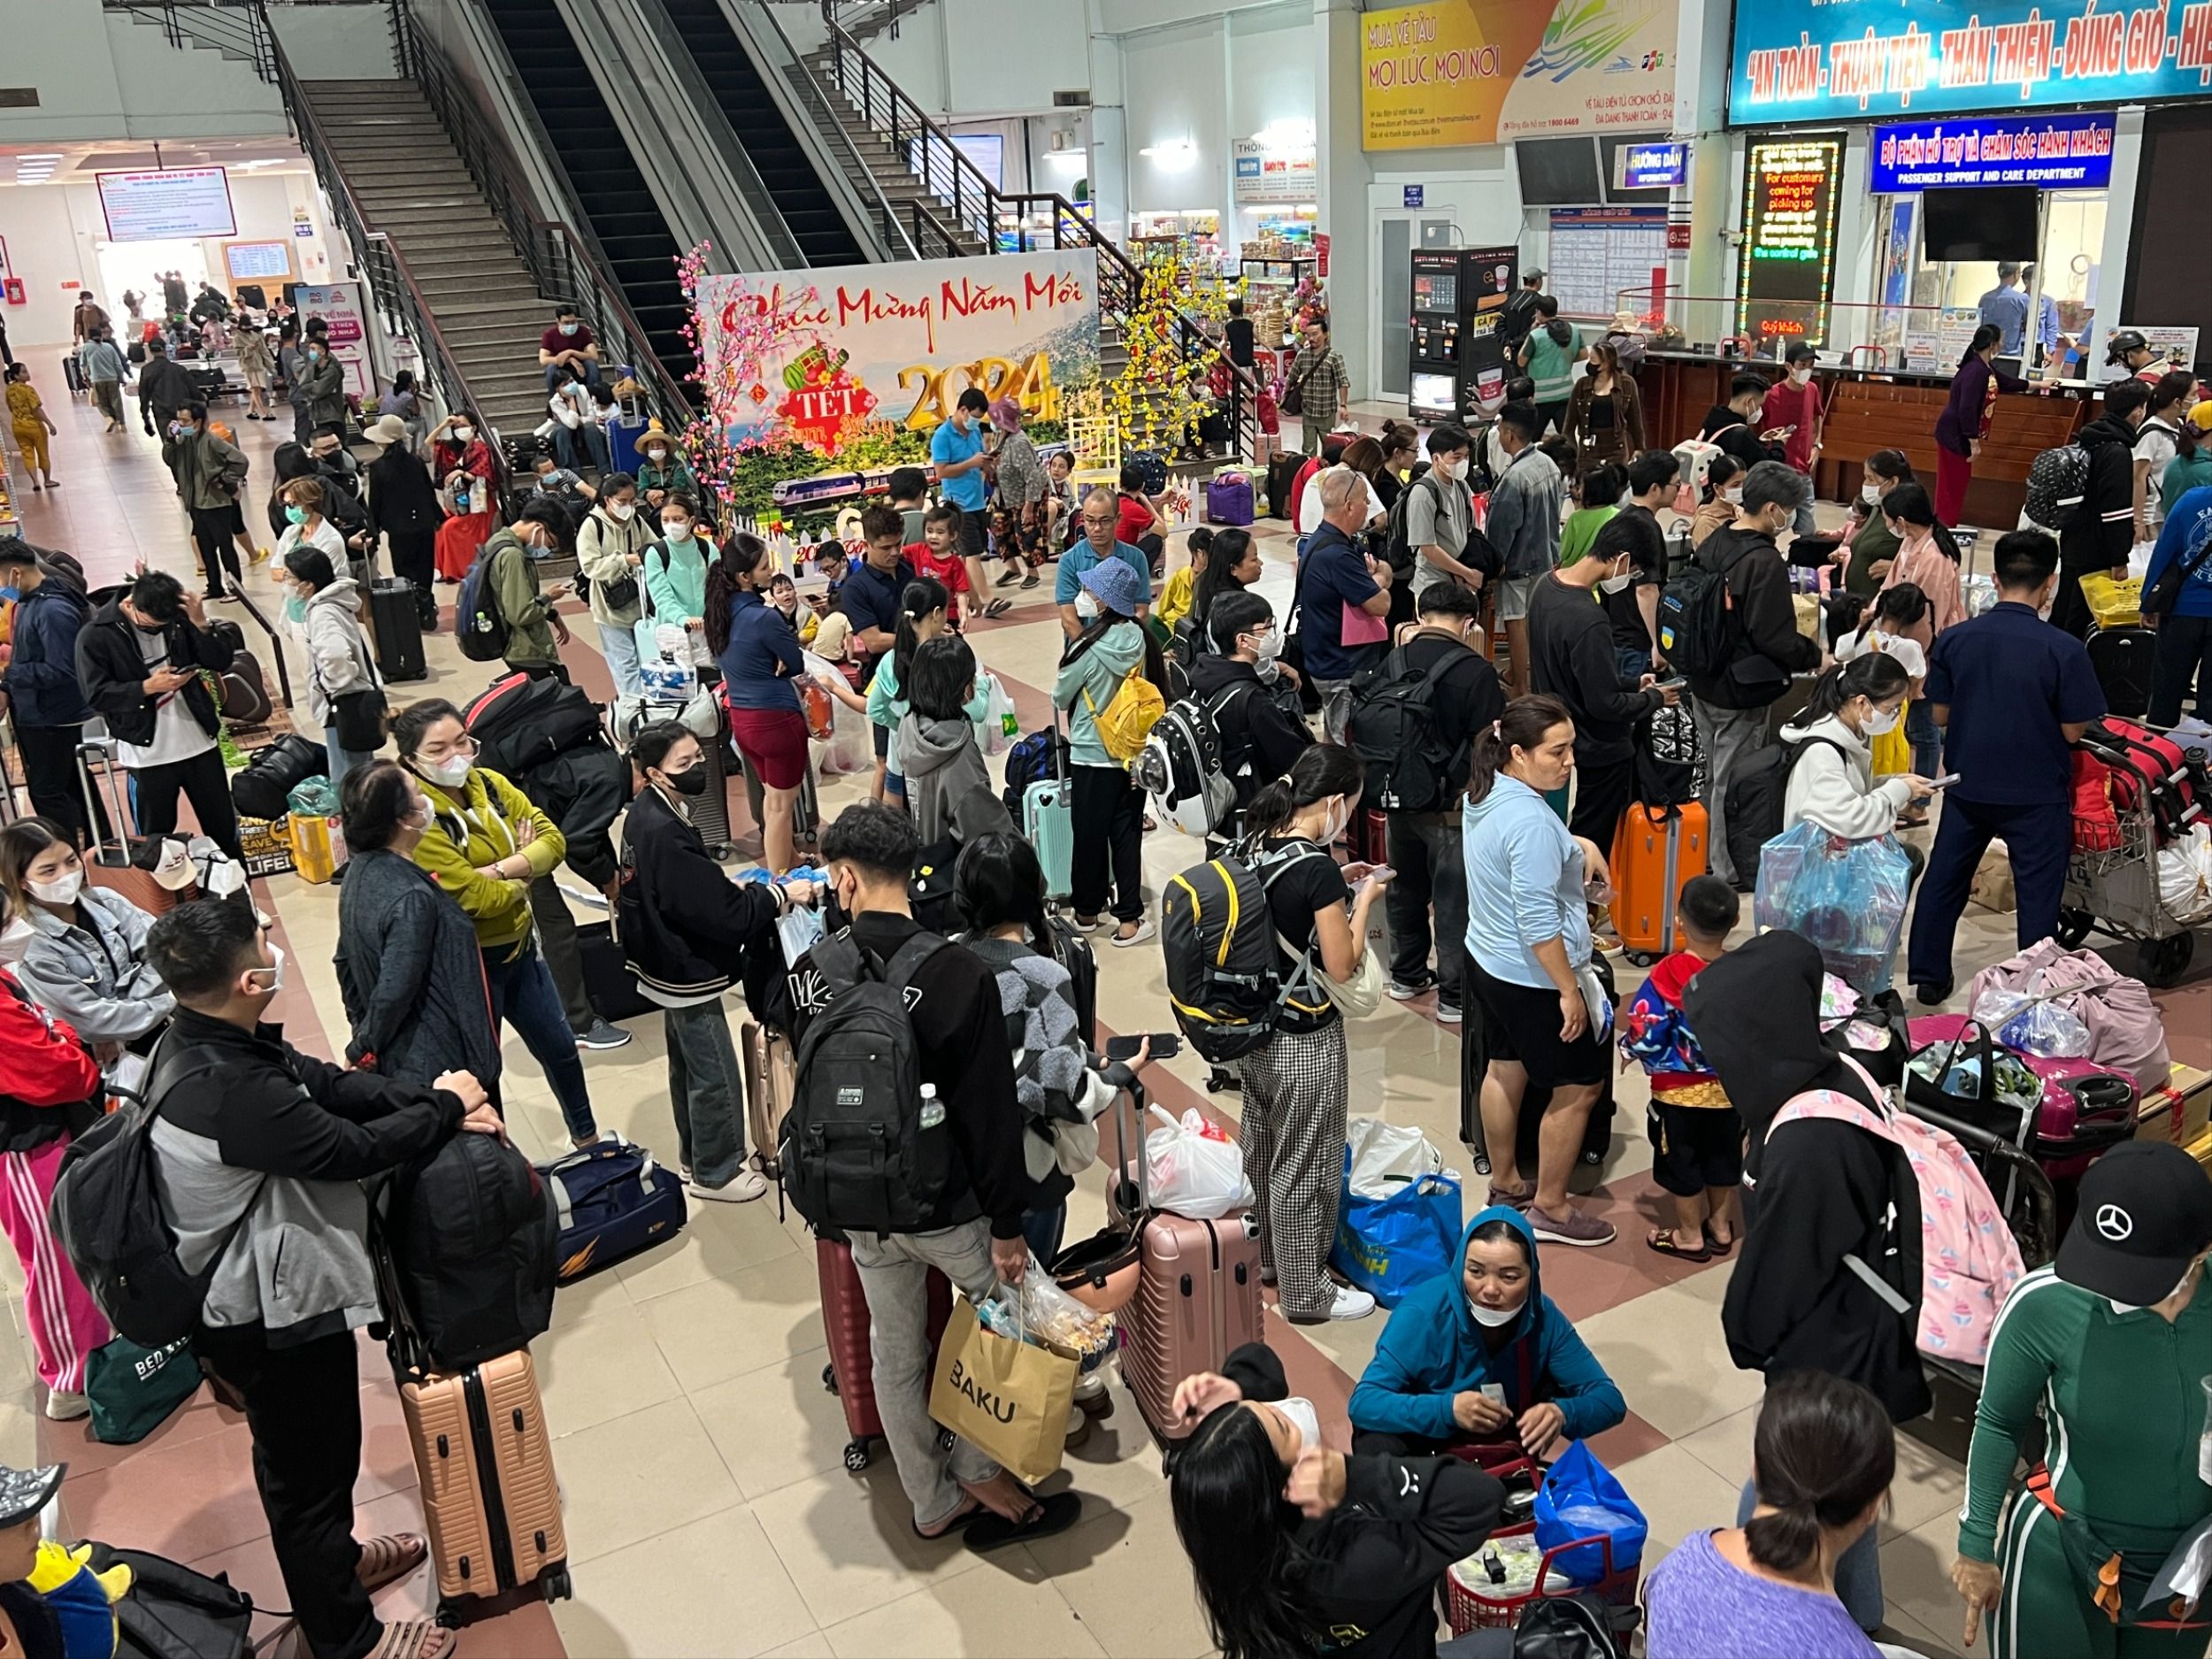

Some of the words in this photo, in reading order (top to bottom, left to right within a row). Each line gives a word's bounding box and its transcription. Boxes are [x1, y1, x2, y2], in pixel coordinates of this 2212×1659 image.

[1368, 22, 1394, 50] MUA
[1412, 10, 1438, 44] TÀU
[1641, 50, 1664, 72] FPT
[1778, 31, 1821, 101] TOÀN
[1829, 26, 1887, 111] THUẬN
[1887, 21, 1931, 107] TIỆN
[1939, 14, 1993, 88] THÂN
[1993, 8, 2055, 99] THIỆN
[2062, 0, 2125, 80] ĐÚNG
[2124, 0, 2170, 75] GIỜ
[1369, 58, 1397, 93] MỌI
[1435, 50, 1467, 88] MỌI
[1470, 44, 1502, 78] NƠI
[1564, 117, 1579, 126] 6469
[1881, 134, 1896, 170] BỘ
[1897, 133, 1925, 169] PHẬN
[1942, 133, 1965, 167] TRỢ
[1965, 129, 1979, 162] VÀ
[1981, 129, 2013, 161] CHĂM
[2013, 127, 2037, 160] SÓC
[2037, 125, 2070, 158] HÀNH
[2070, 122, 2111, 157] KHÁCH
[1631, 150, 1662, 169] HƯỚNG
[1663, 147, 1682, 167] DẪN
[1765, 173, 1780, 183] For
[1781, 173, 1824, 182] customers
[1898, 172, 1943, 184] PASSENGER
[1944, 171, 1982, 182] SUPPORT
[1982, 170, 2000, 181] AND
[2001, 169, 2024, 180] CARE
[2025, 167, 2086, 180] DEPARTMENT
[1769, 186, 1800, 197] coming
[1801, 185, 1815, 195] for
[1769, 198, 1800, 211] picking
[1801, 200, 1814, 210] up
[1770, 248, 1799, 257] control
[837, 285, 934, 354] Mừng
[941, 276, 1018, 321] Năm
[1024, 271, 1084, 311] Mới
[797, 381, 856, 419] TẾT
[242, 836, 273, 849] SAVE
[247, 856, 290, 875] LIFE!
[949, 1358, 1016, 1424] BAKU
